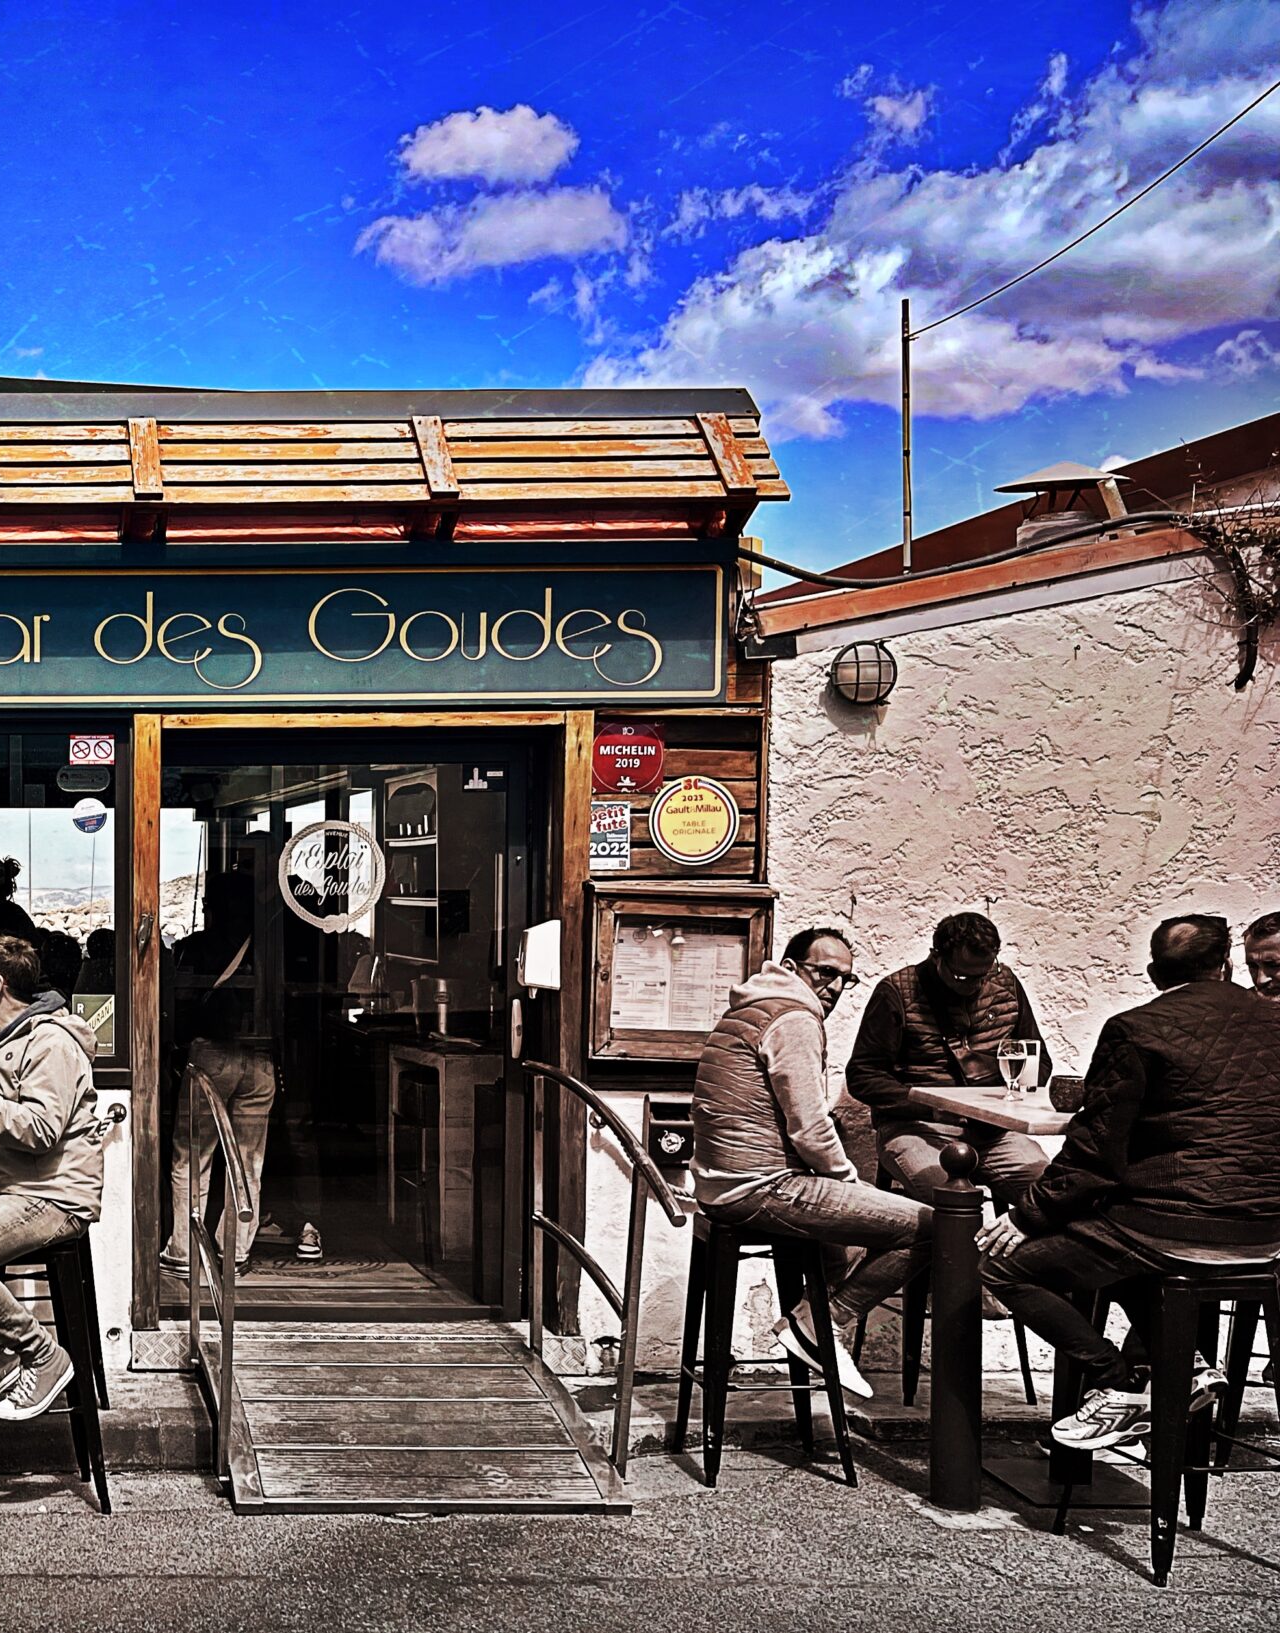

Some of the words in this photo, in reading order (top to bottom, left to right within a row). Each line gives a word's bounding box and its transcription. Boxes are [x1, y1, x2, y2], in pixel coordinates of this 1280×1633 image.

[93, 589, 263, 689] des
[307, 586, 664, 687] Goudes
[599, 745, 656, 756] MICHELIN
[615, 758, 640, 768] 2019
[682, 794, 704, 802] 2023
[591, 805, 626, 823] petit
[596, 817, 628, 832] futé
[590, 842, 629, 856] 2022
[294, 878, 315, 896] des
[77, 1004, 85, 1014] R
